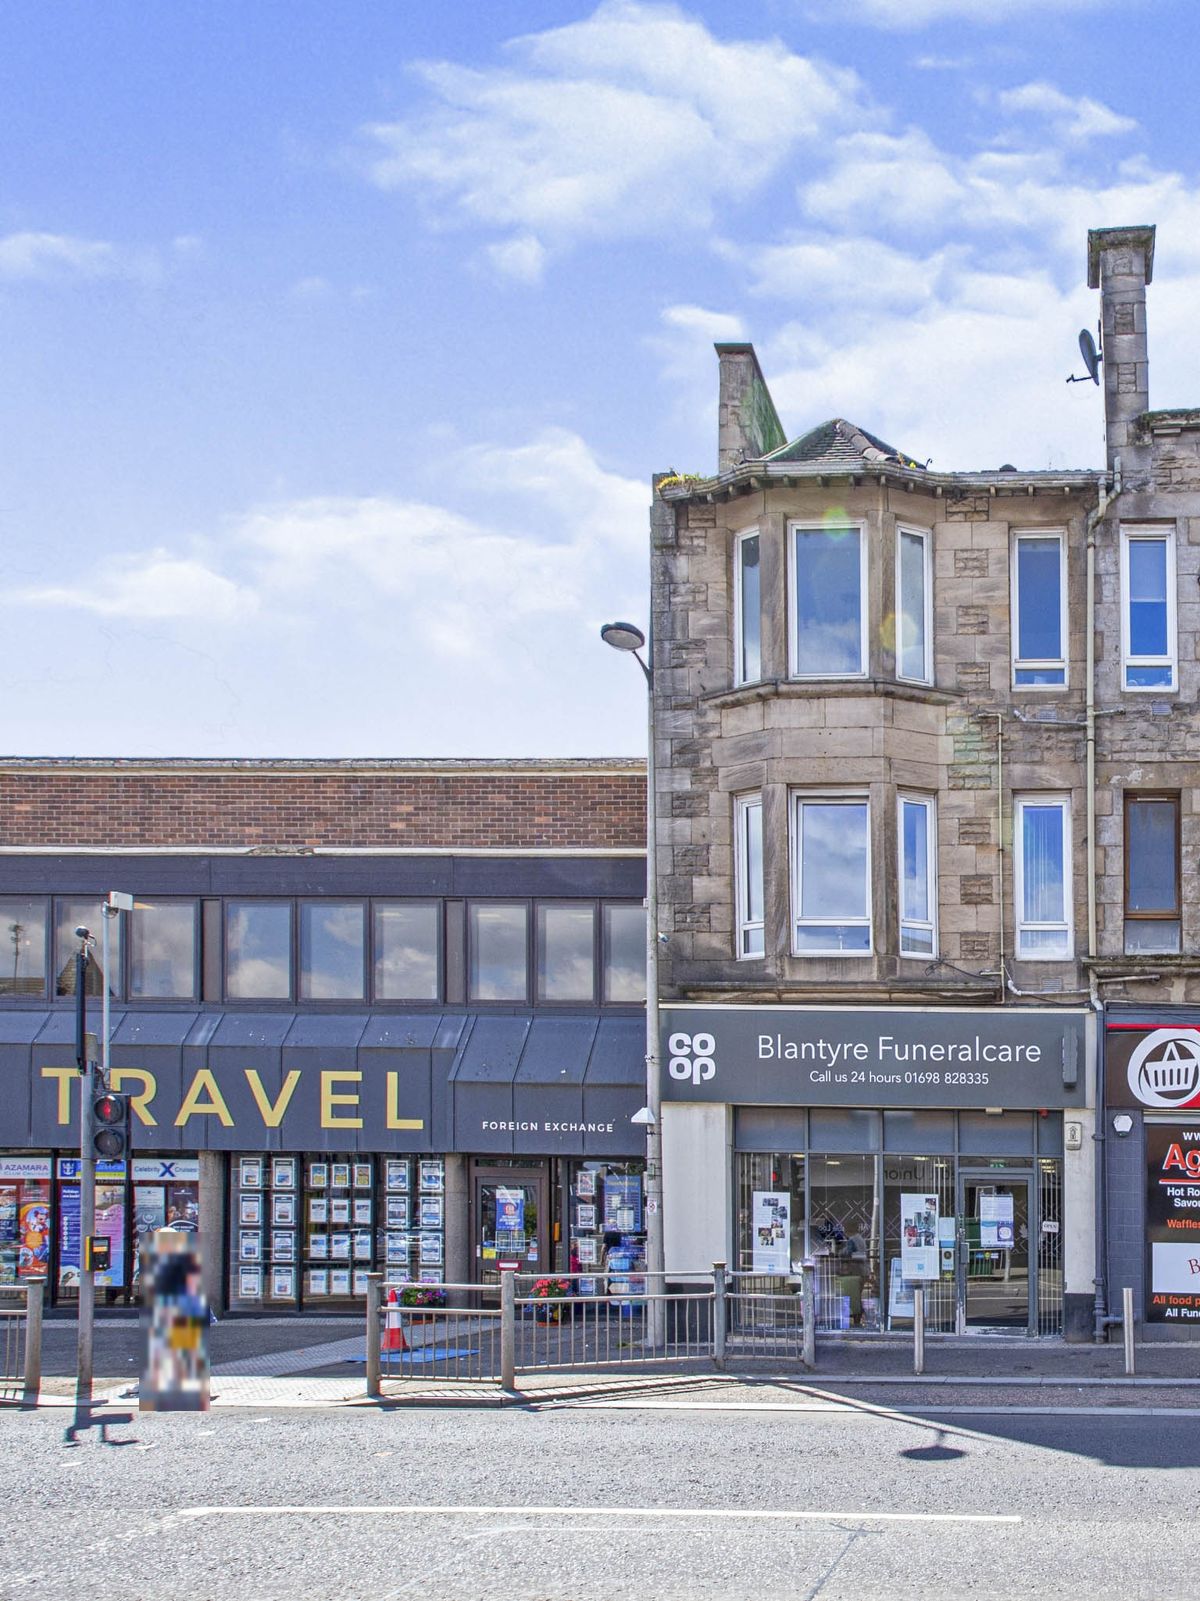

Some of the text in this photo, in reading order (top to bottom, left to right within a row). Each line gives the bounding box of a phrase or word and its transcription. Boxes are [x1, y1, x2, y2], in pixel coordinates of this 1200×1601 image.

[758, 1033, 1041, 1067] Blantyre Funeralcare
[809, 1070, 989, 1085] Call us 24 hours 01698 828335
[41, 1067, 424, 1130] TRAVEL
[482, 1121, 614, 1133] FOREIGN EXCHANGE
[1167, 1186, 1185, 1197] Hot
[1152, 1295, 1166, 1305] All
[1169, 1296, 1191, 1305] food
[1165, 1308, 1178, 1317] All
